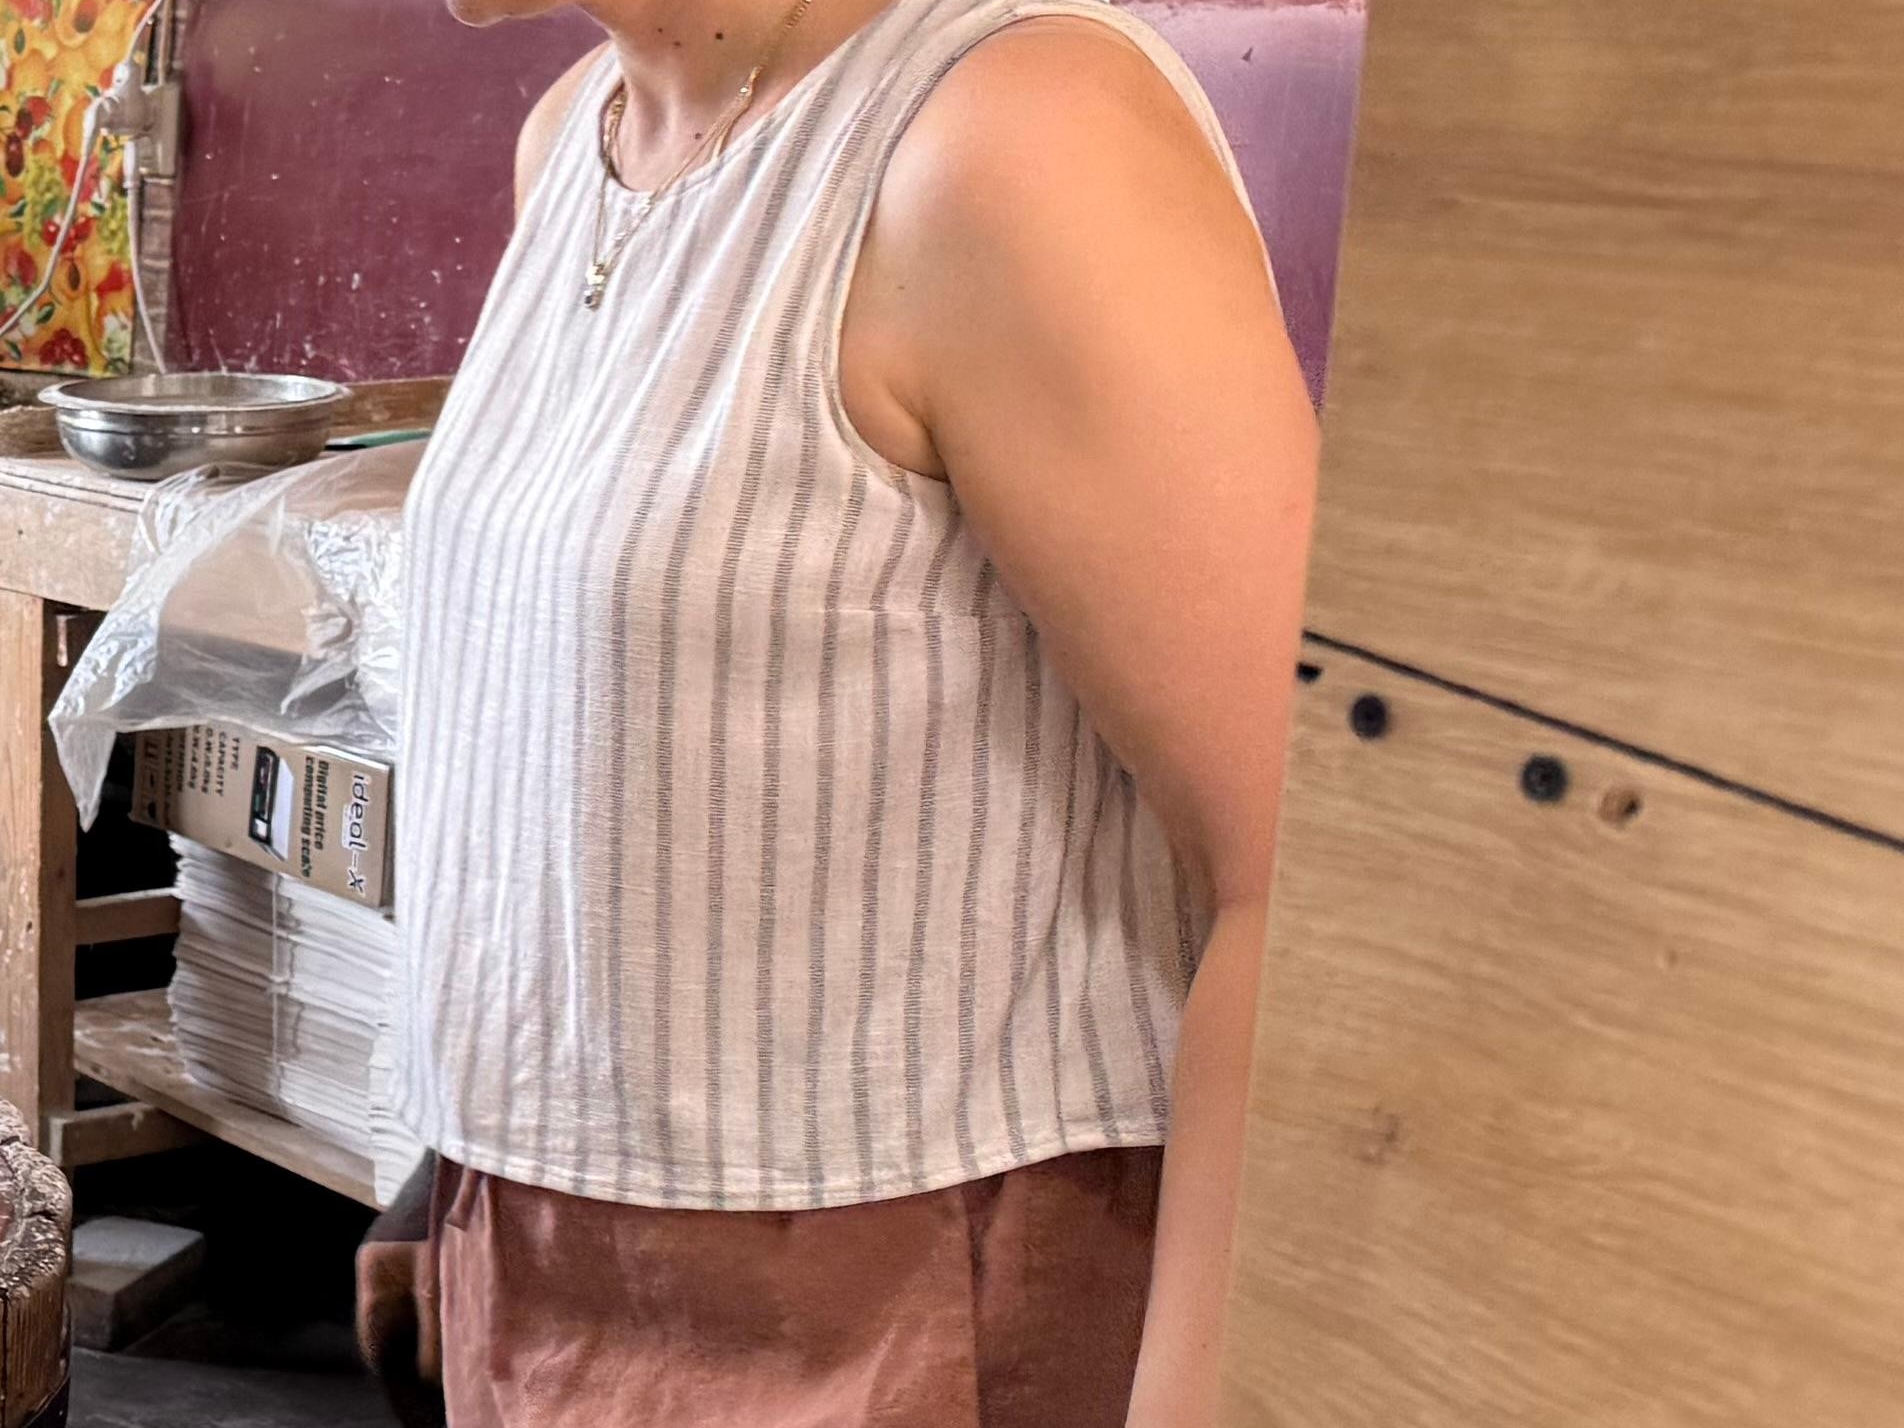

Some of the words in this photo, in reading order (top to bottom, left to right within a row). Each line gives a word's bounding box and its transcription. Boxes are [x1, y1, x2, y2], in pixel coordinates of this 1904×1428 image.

[216, 732, 228, 796] CAPACITY
[230, 737, 241, 771] TYPE
[300, 756, 316, 836] computing
[314, 760, 330, 809] Digital
[313, 811, 327, 851] price
[300, 838, 313, 878] scale
